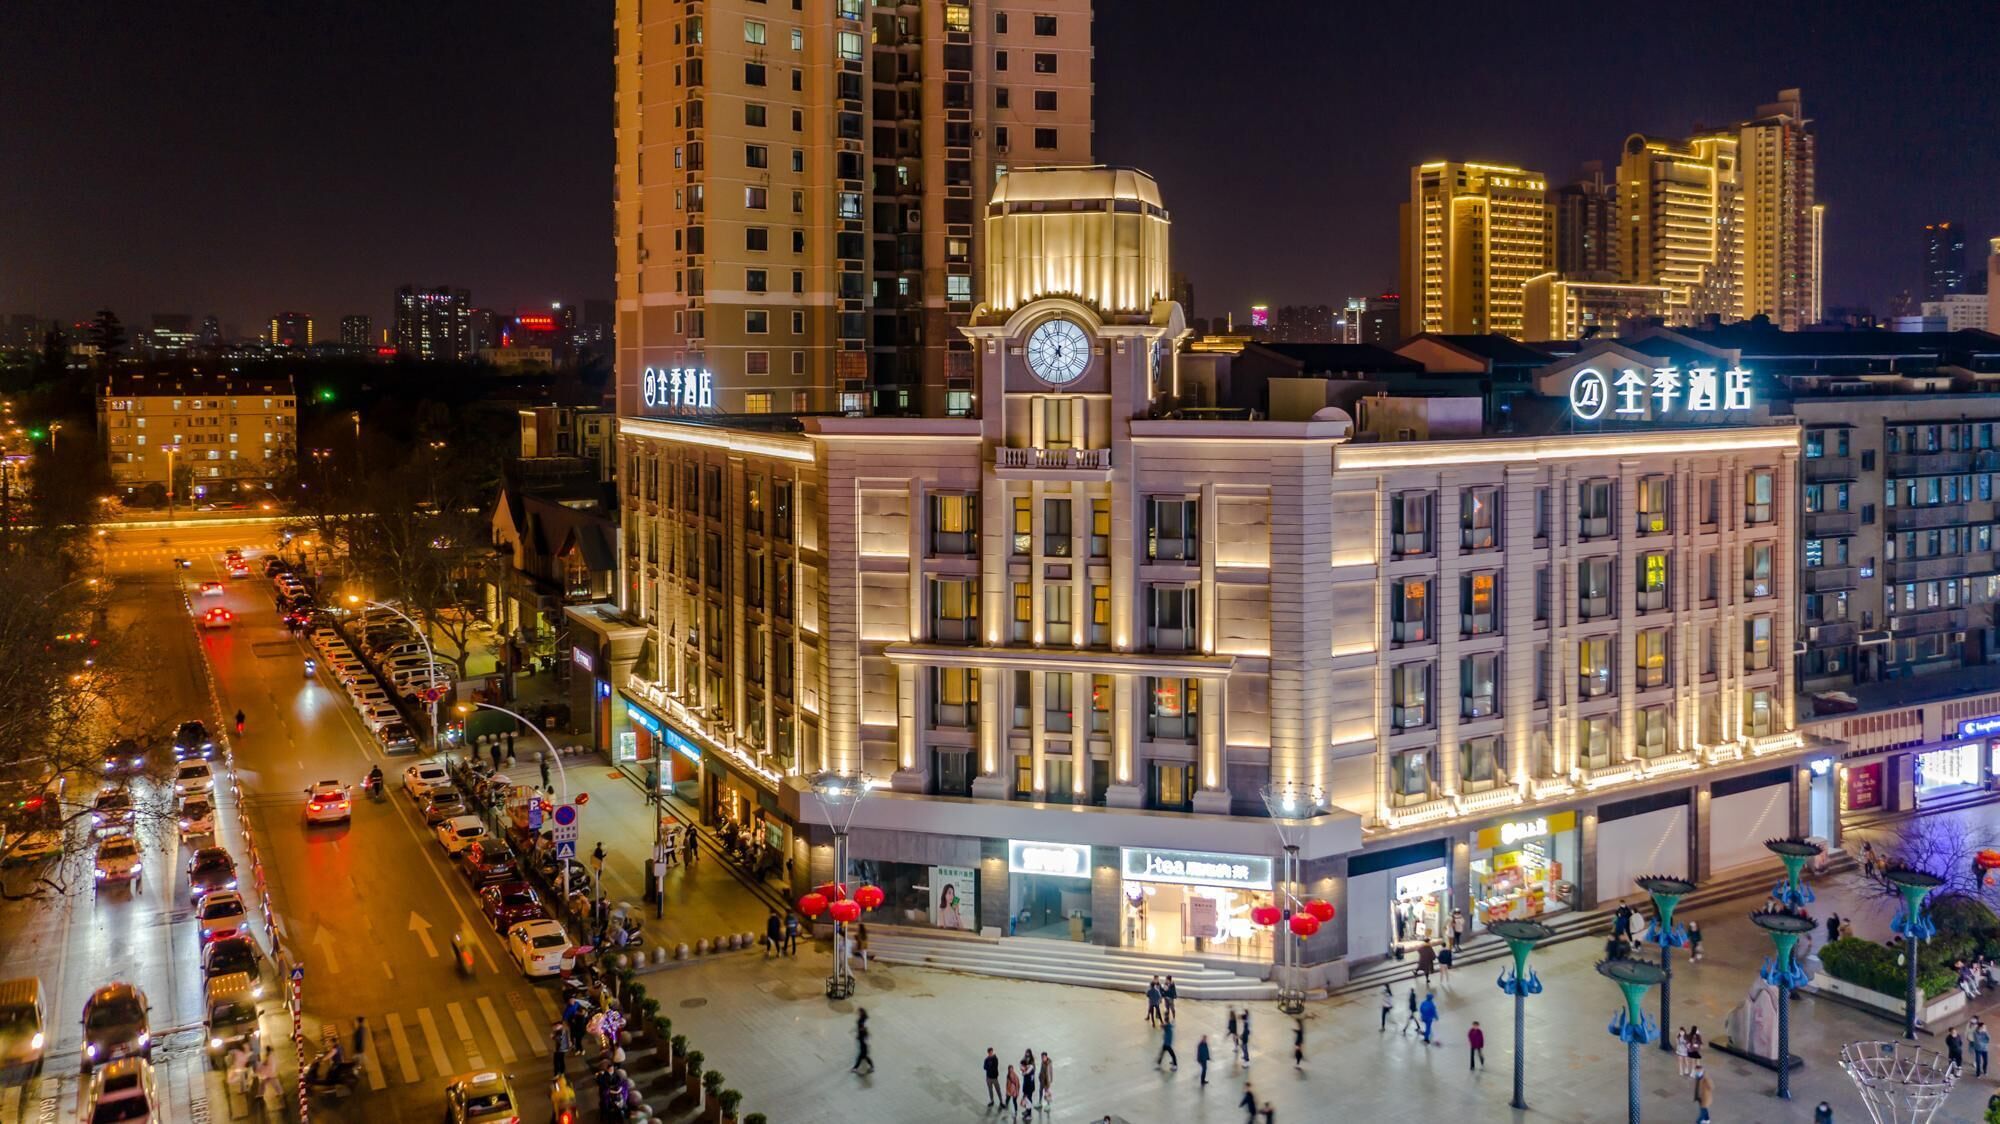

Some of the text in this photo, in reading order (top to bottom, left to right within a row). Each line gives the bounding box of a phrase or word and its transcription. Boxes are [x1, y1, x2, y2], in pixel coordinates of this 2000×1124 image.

[657, 368, 711, 408] 全季酒店
[1613, 366, 1752, 413] 全季酒店
